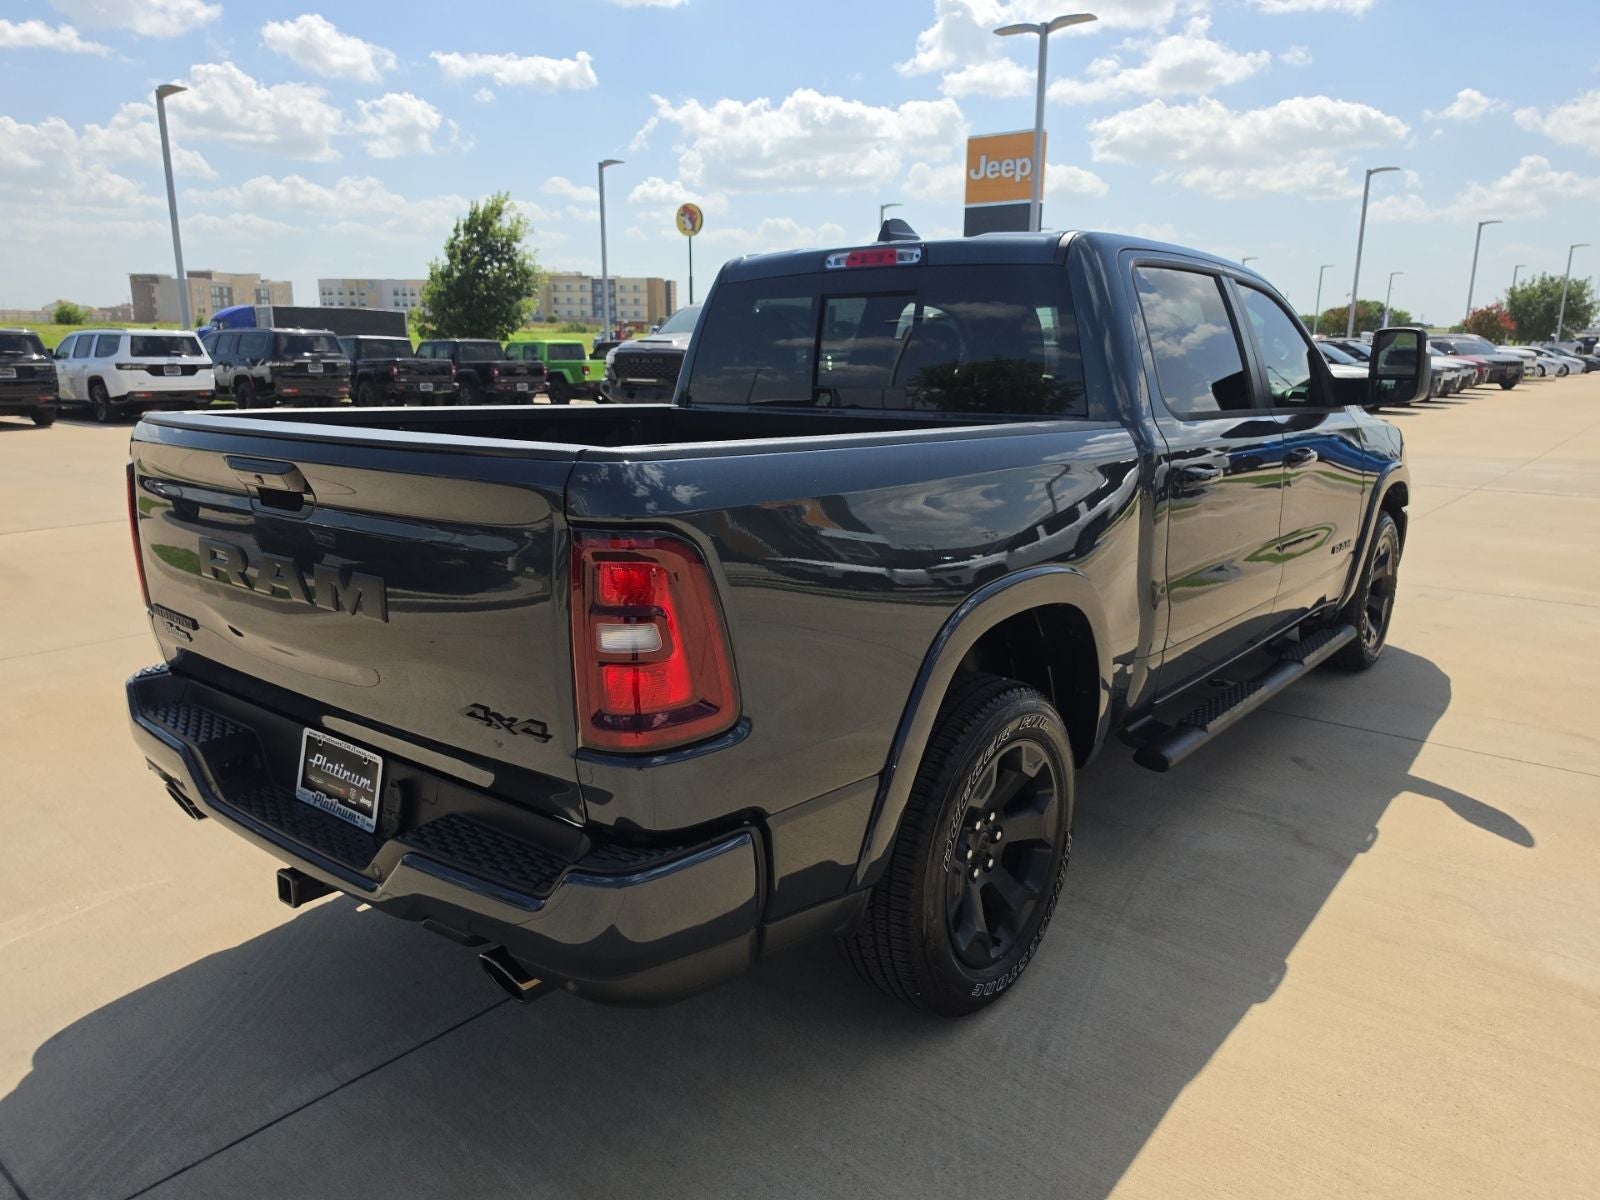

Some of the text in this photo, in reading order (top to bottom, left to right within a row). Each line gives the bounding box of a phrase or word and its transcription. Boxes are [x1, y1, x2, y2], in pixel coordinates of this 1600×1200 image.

[969, 154, 1032, 183] Jeep
[199, 535, 389, 624] RAM
[308, 752, 374, 793] Platinum
[313, 791, 361, 825] Platinum
